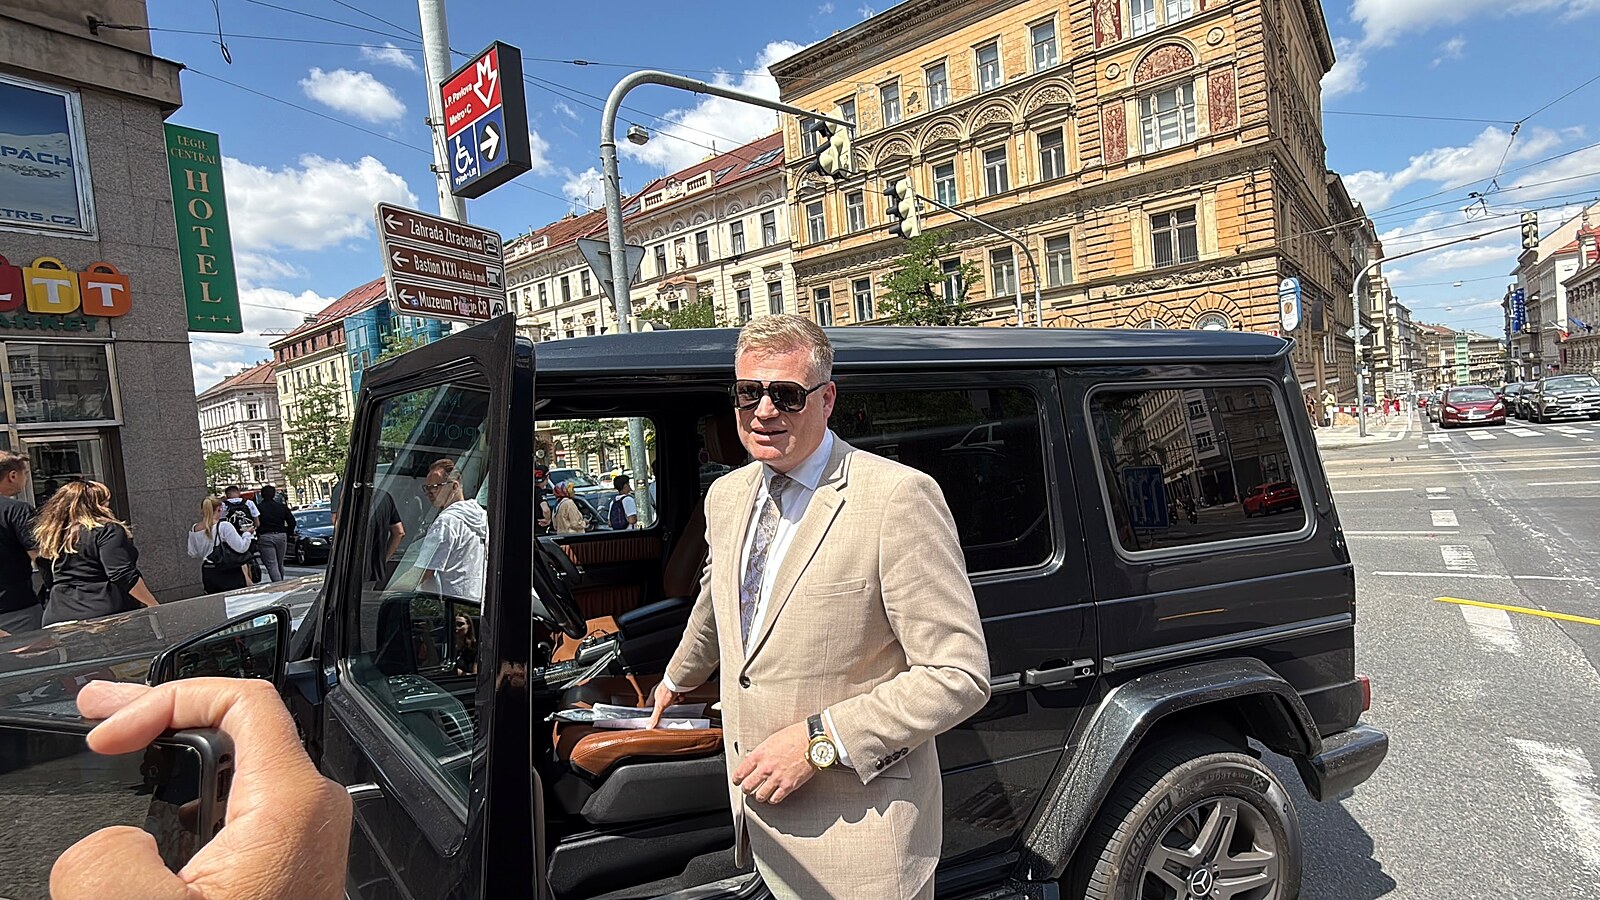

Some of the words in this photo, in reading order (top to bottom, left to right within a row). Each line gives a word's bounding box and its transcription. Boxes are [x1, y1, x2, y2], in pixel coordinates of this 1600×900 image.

[177, 135, 208, 150] LEGIE
[170, 147, 216, 164] CENTRAL
[0, 208, 76, 225] TRS.CZ
[183, 168, 222, 303] HOTEL
[408, 218, 444, 241] Zahrada
[444, 227, 483, 250] Ztracenka
[413, 254, 441, 275] Bastion
[440, 259, 458, 278] XXXI
[418, 290, 453, 311] Muzeum
[477, 297, 489, 316] ČR
[1121, 797, 1171, 878] MICHELIN
